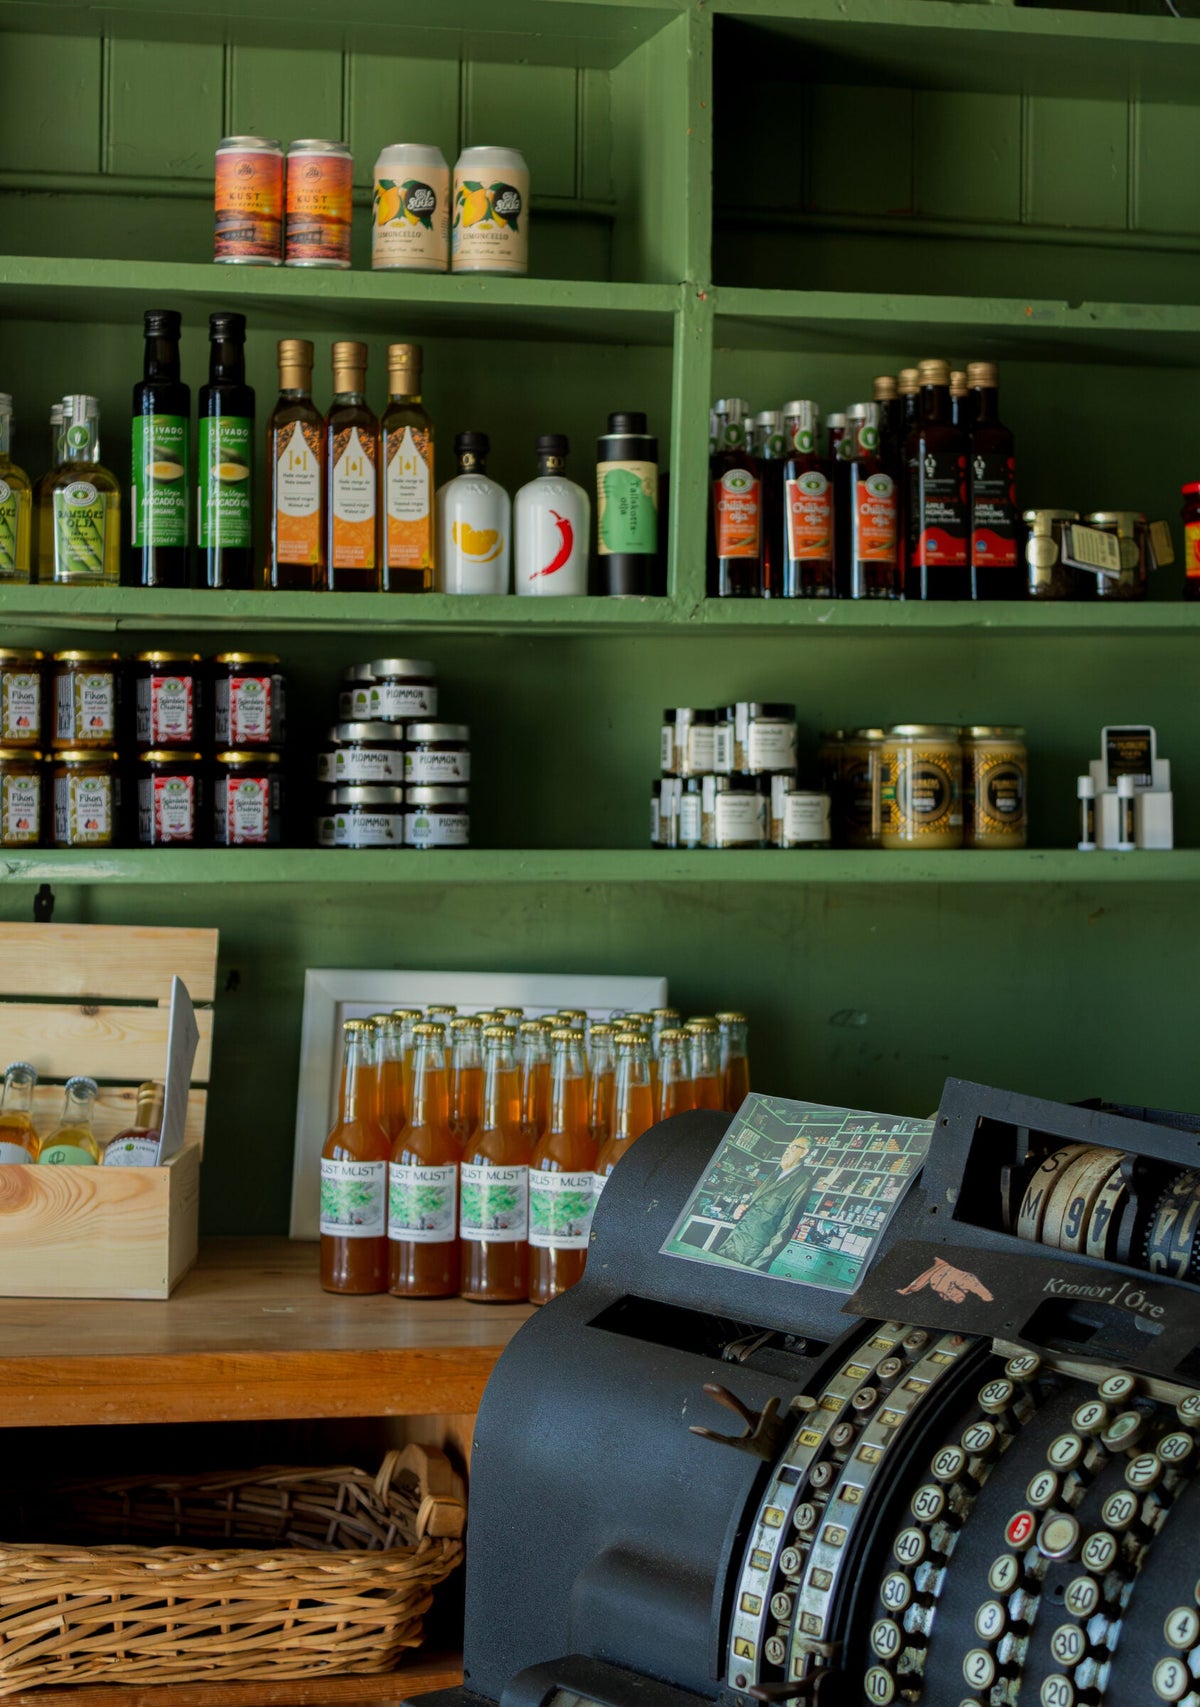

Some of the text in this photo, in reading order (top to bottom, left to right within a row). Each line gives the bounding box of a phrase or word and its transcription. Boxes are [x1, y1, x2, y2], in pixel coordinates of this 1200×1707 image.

[230, 192, 261, 201] KUST
[58, 509, 104, 519] RAMSLÖKS
[386, 689, 423, 699] PLOMMON
[351, 753, 388, 762] PLOMMON
[420, 755, 457, 764] PLOMMON
[353, 818, 390, 827] PLOMMON
[439, 817, 468, 827] PLOMMO
[1040, 1152, 1068, 1173] S
[342, 1166, 375, 1177] MUST
[413, 1170, 447, 1181] MUST
[487, 1170, 520, 1180] MUST
[560, 1176, 593, 1187] MUST
[1014, 1357, 1034, 1372] 90
[987, 1384, 1010, 1401] 80
[1114, 1378, 1125, 1393] 9
[886, 1414, 898, 1425] 3
[1082, 1408, 1097, 1423] 8
[804, 1432, 817, 1443] MAT
[966, 1428, 989, 1446] 70
[864, 1450, 875, 1460] 4
[1060, 1442, 1074, 1458] 7
[1162, 1438, 1188, 1457] 80
[938, 1452, 959, 1472] 60
[848, 1488, 860, 1501] 5
[1038, 1478, 1049, 1497] 6
[917, 1492, 941, 1513] 50
[1108, 1499, 1131, 1519] 60
[1014, 1518, 1029, 1538] 5
[830, 1530, 841, 1543] 6
[898, 1536, 921, 1557] 40
[1088, 1539, 1112, 1561] 50
[998, 1561, 1009, 1580] 4
[818, 1574, 828, 1587] 7
[885, 1582, 906, 1603] 30
[1071, 1586, 1095, 1608] 40
[806, 1617, 818, 1631] 8
[984, 1608, 996, 1630] 3
[1178, 1617, 1188, 1637] 4
[874, 1628, 897, 1650] 20
[1056, 1633, 1079, 1656] 30
[742, 1644, 751, 1658] A
[872, 1675, 888, 1696] 10
[1164, 1667, 1176, 1689] 3
[1048, 1682, 1070, 1707] 20
